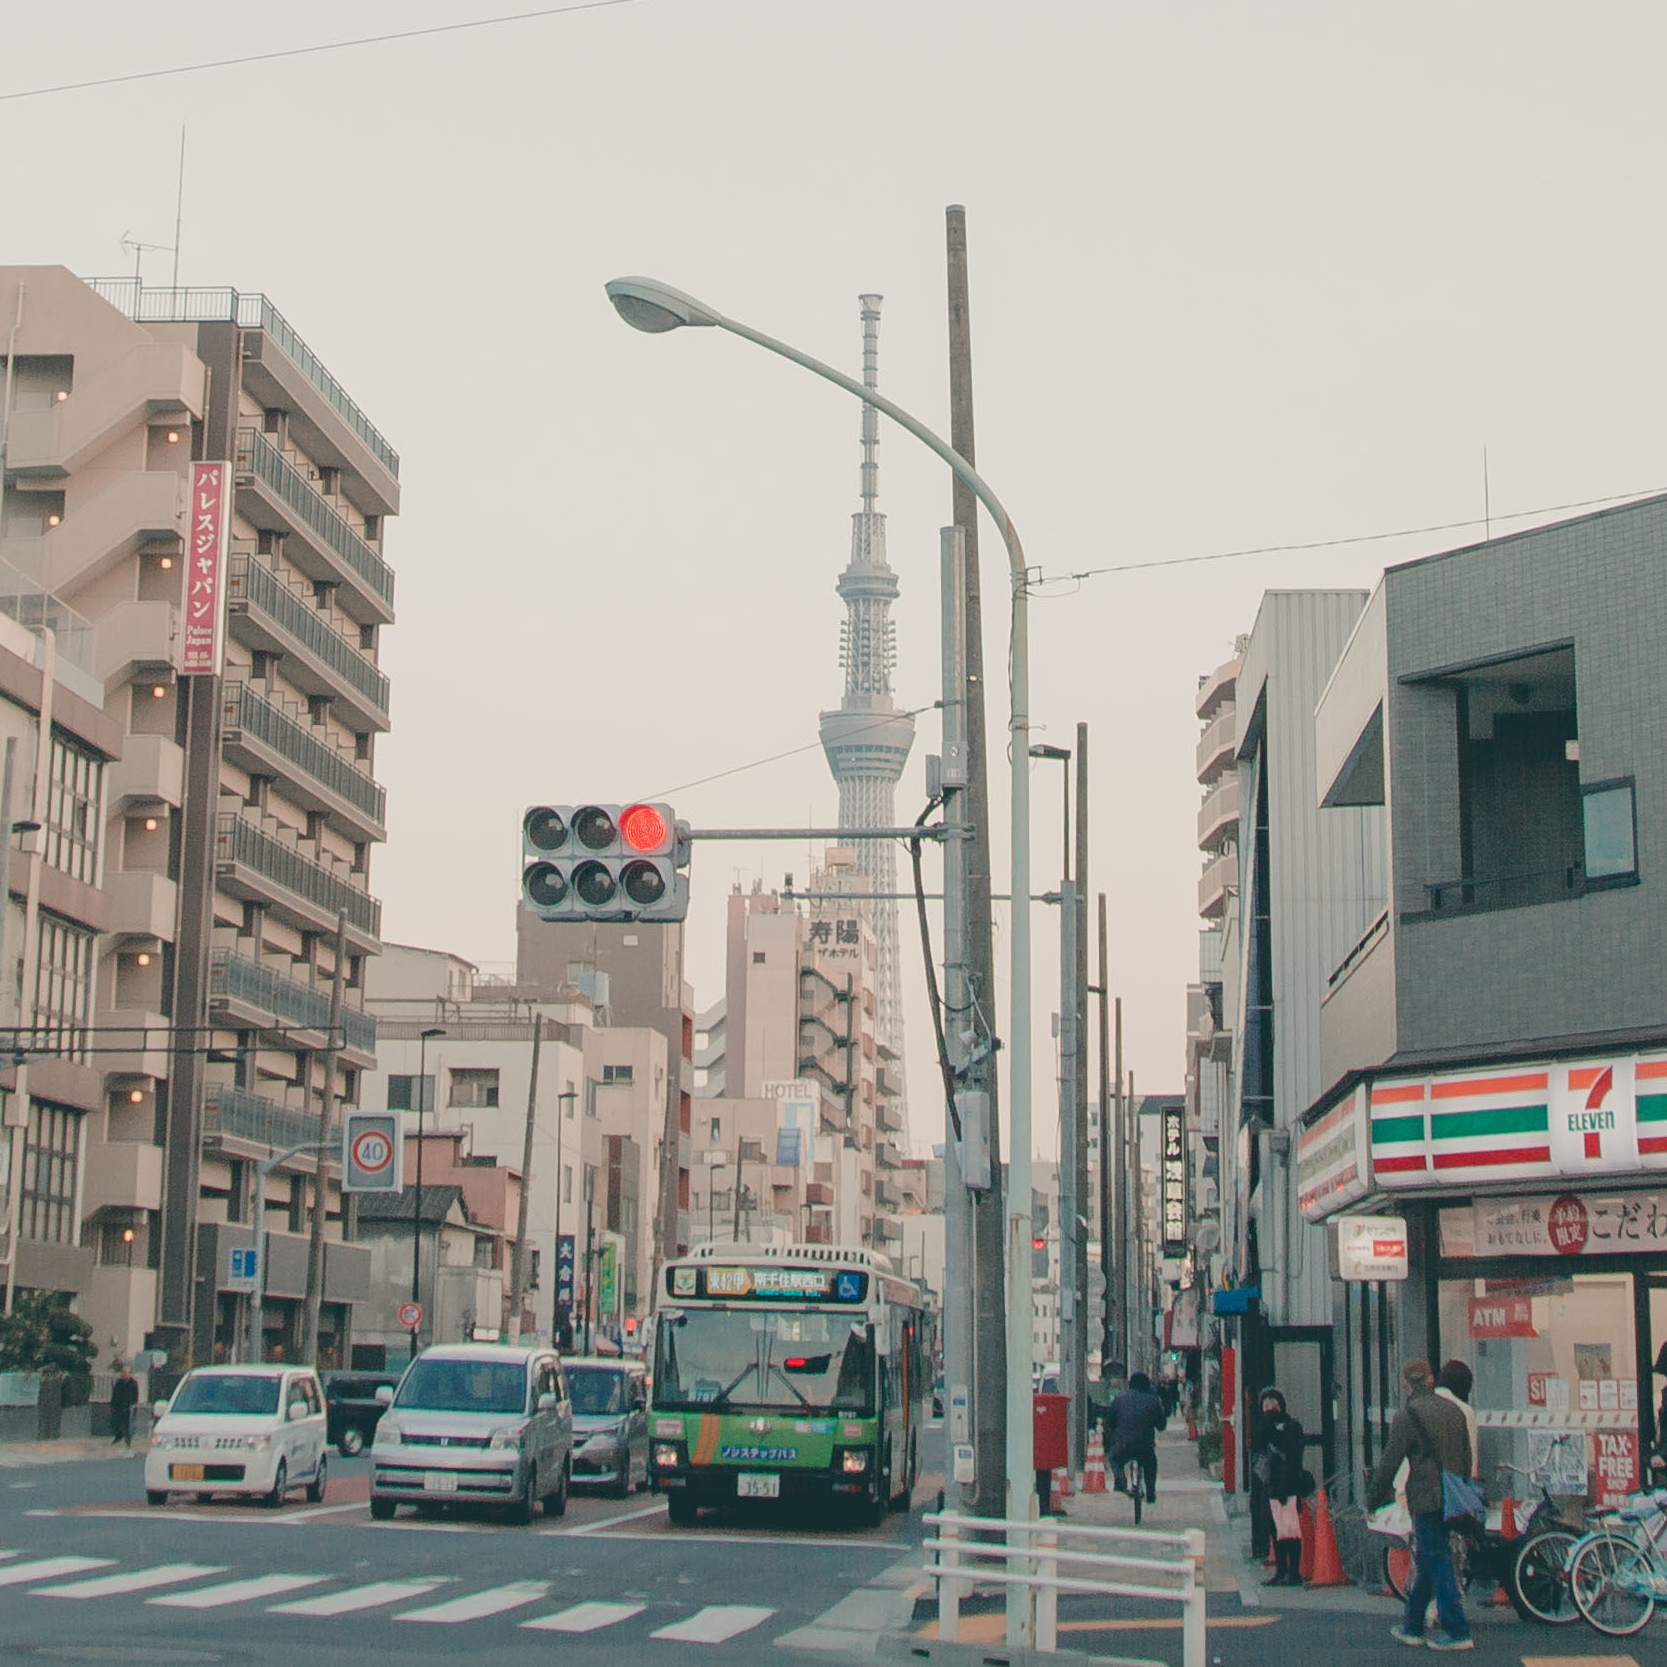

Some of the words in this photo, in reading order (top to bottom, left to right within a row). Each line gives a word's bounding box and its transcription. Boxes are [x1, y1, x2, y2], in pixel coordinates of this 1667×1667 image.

[190, 469, 219, 618] パレスジャパン
[186, 635, 212, 646] Japan
[808, 919, 860, 945] 寿陽
[764, 1083, 814, 1099] HOTEL
[1166, 1114, 1181, 1156] ホテル
[361, 1142, 384, 1161] 40
[1472, 1308, 1506, 1327] ATM
[722, 1446, 798, 1461] ノンステップバス
[1599, 1457, 1633, 1478] FREE
